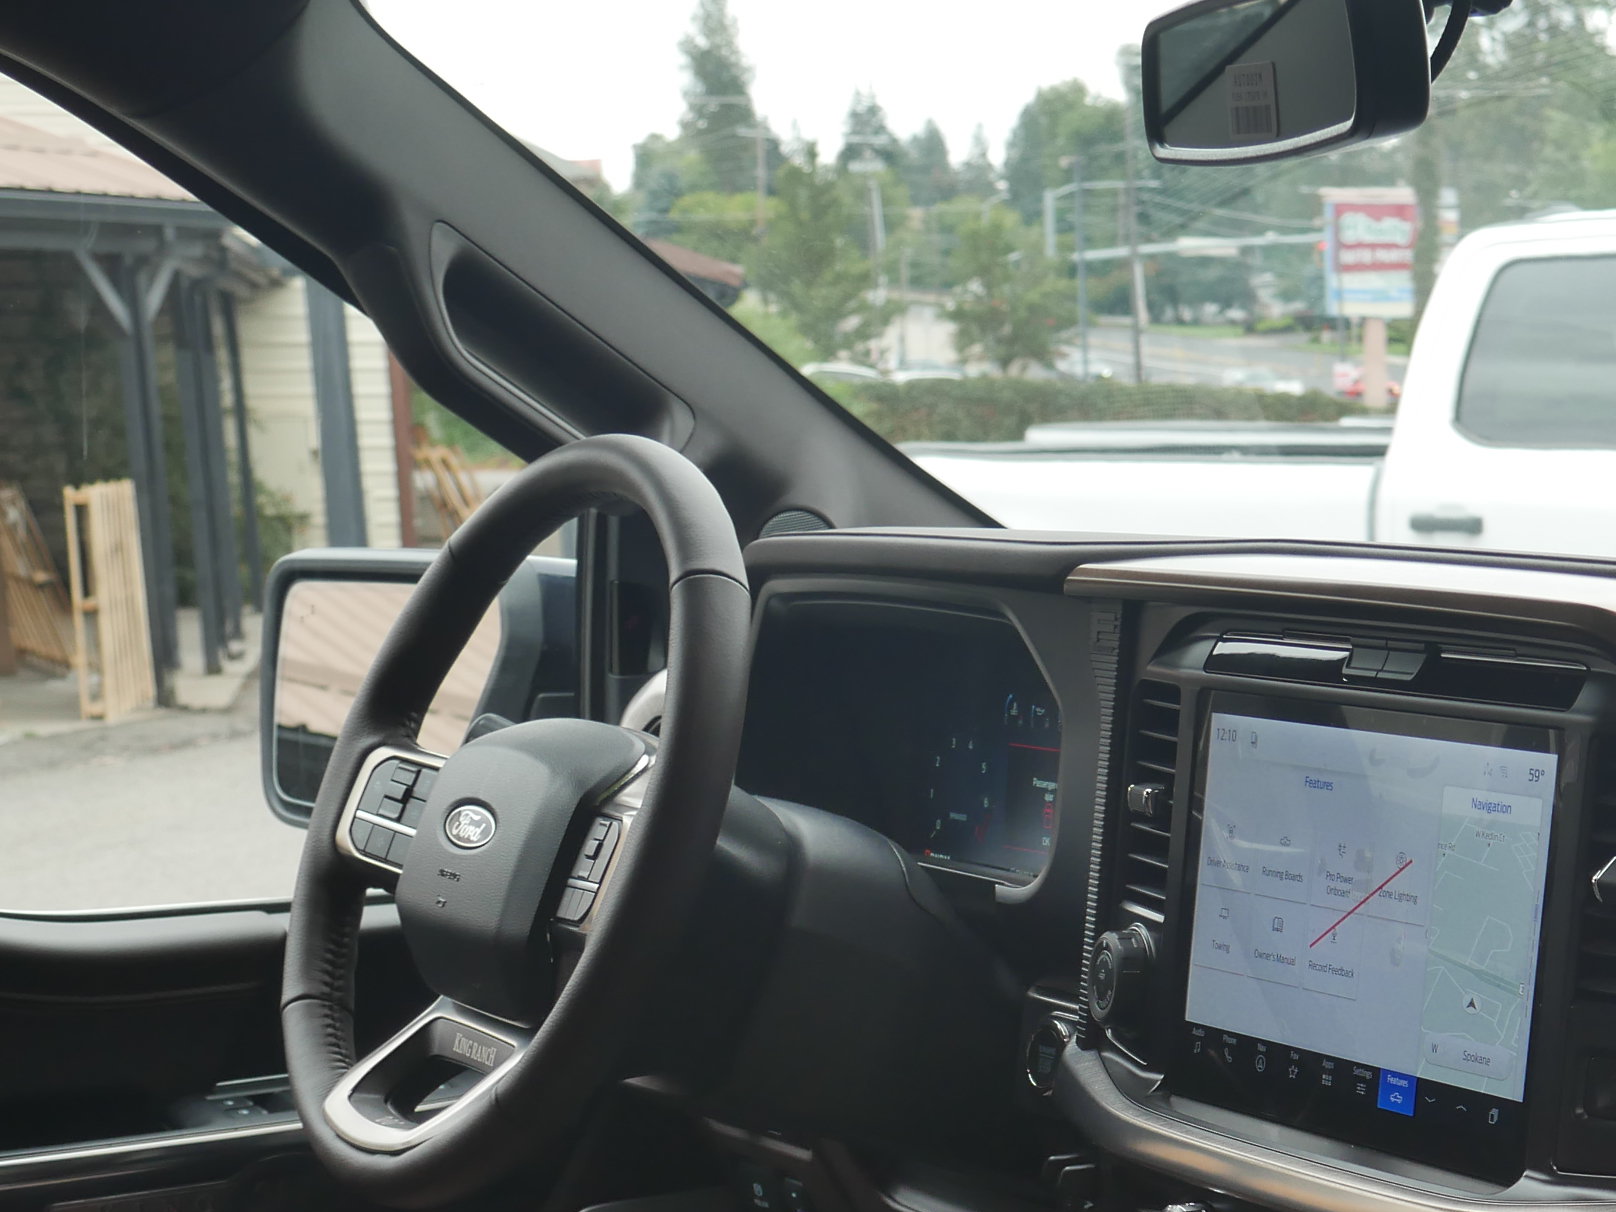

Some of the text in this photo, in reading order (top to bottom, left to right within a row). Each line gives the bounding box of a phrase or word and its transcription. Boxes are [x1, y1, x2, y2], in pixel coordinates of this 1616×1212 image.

[1217, 728, 1237, 742] 12:10
[1528, 768, 1545, 782] 59°
[1305, 776, 1334, 791] Features
[1472, 797, 1512, 814] Navigation
[452, 810, 486, 841] Ford
[1262, 867, 1303, 883] Running Boards
[1326, 871, 1354, 885] Pro Power
[1378, 887, 1418, 905] Zone Lighting
[1212, 939, 1230, 953] Towing
[1254, 949, 1296, 966] Owner's Manual
[1308, 960, 1354, 978] Record Feedback
[1223, 1034, 1237, 1045] Phone
[453, 1032, 497, 1067] KING RANCH
[1431, 1043, 1491, 1066] W Spokane
[1353, 1065, 1372, 1080] Settings
[1387, 1074, 1409, 1088] Features
